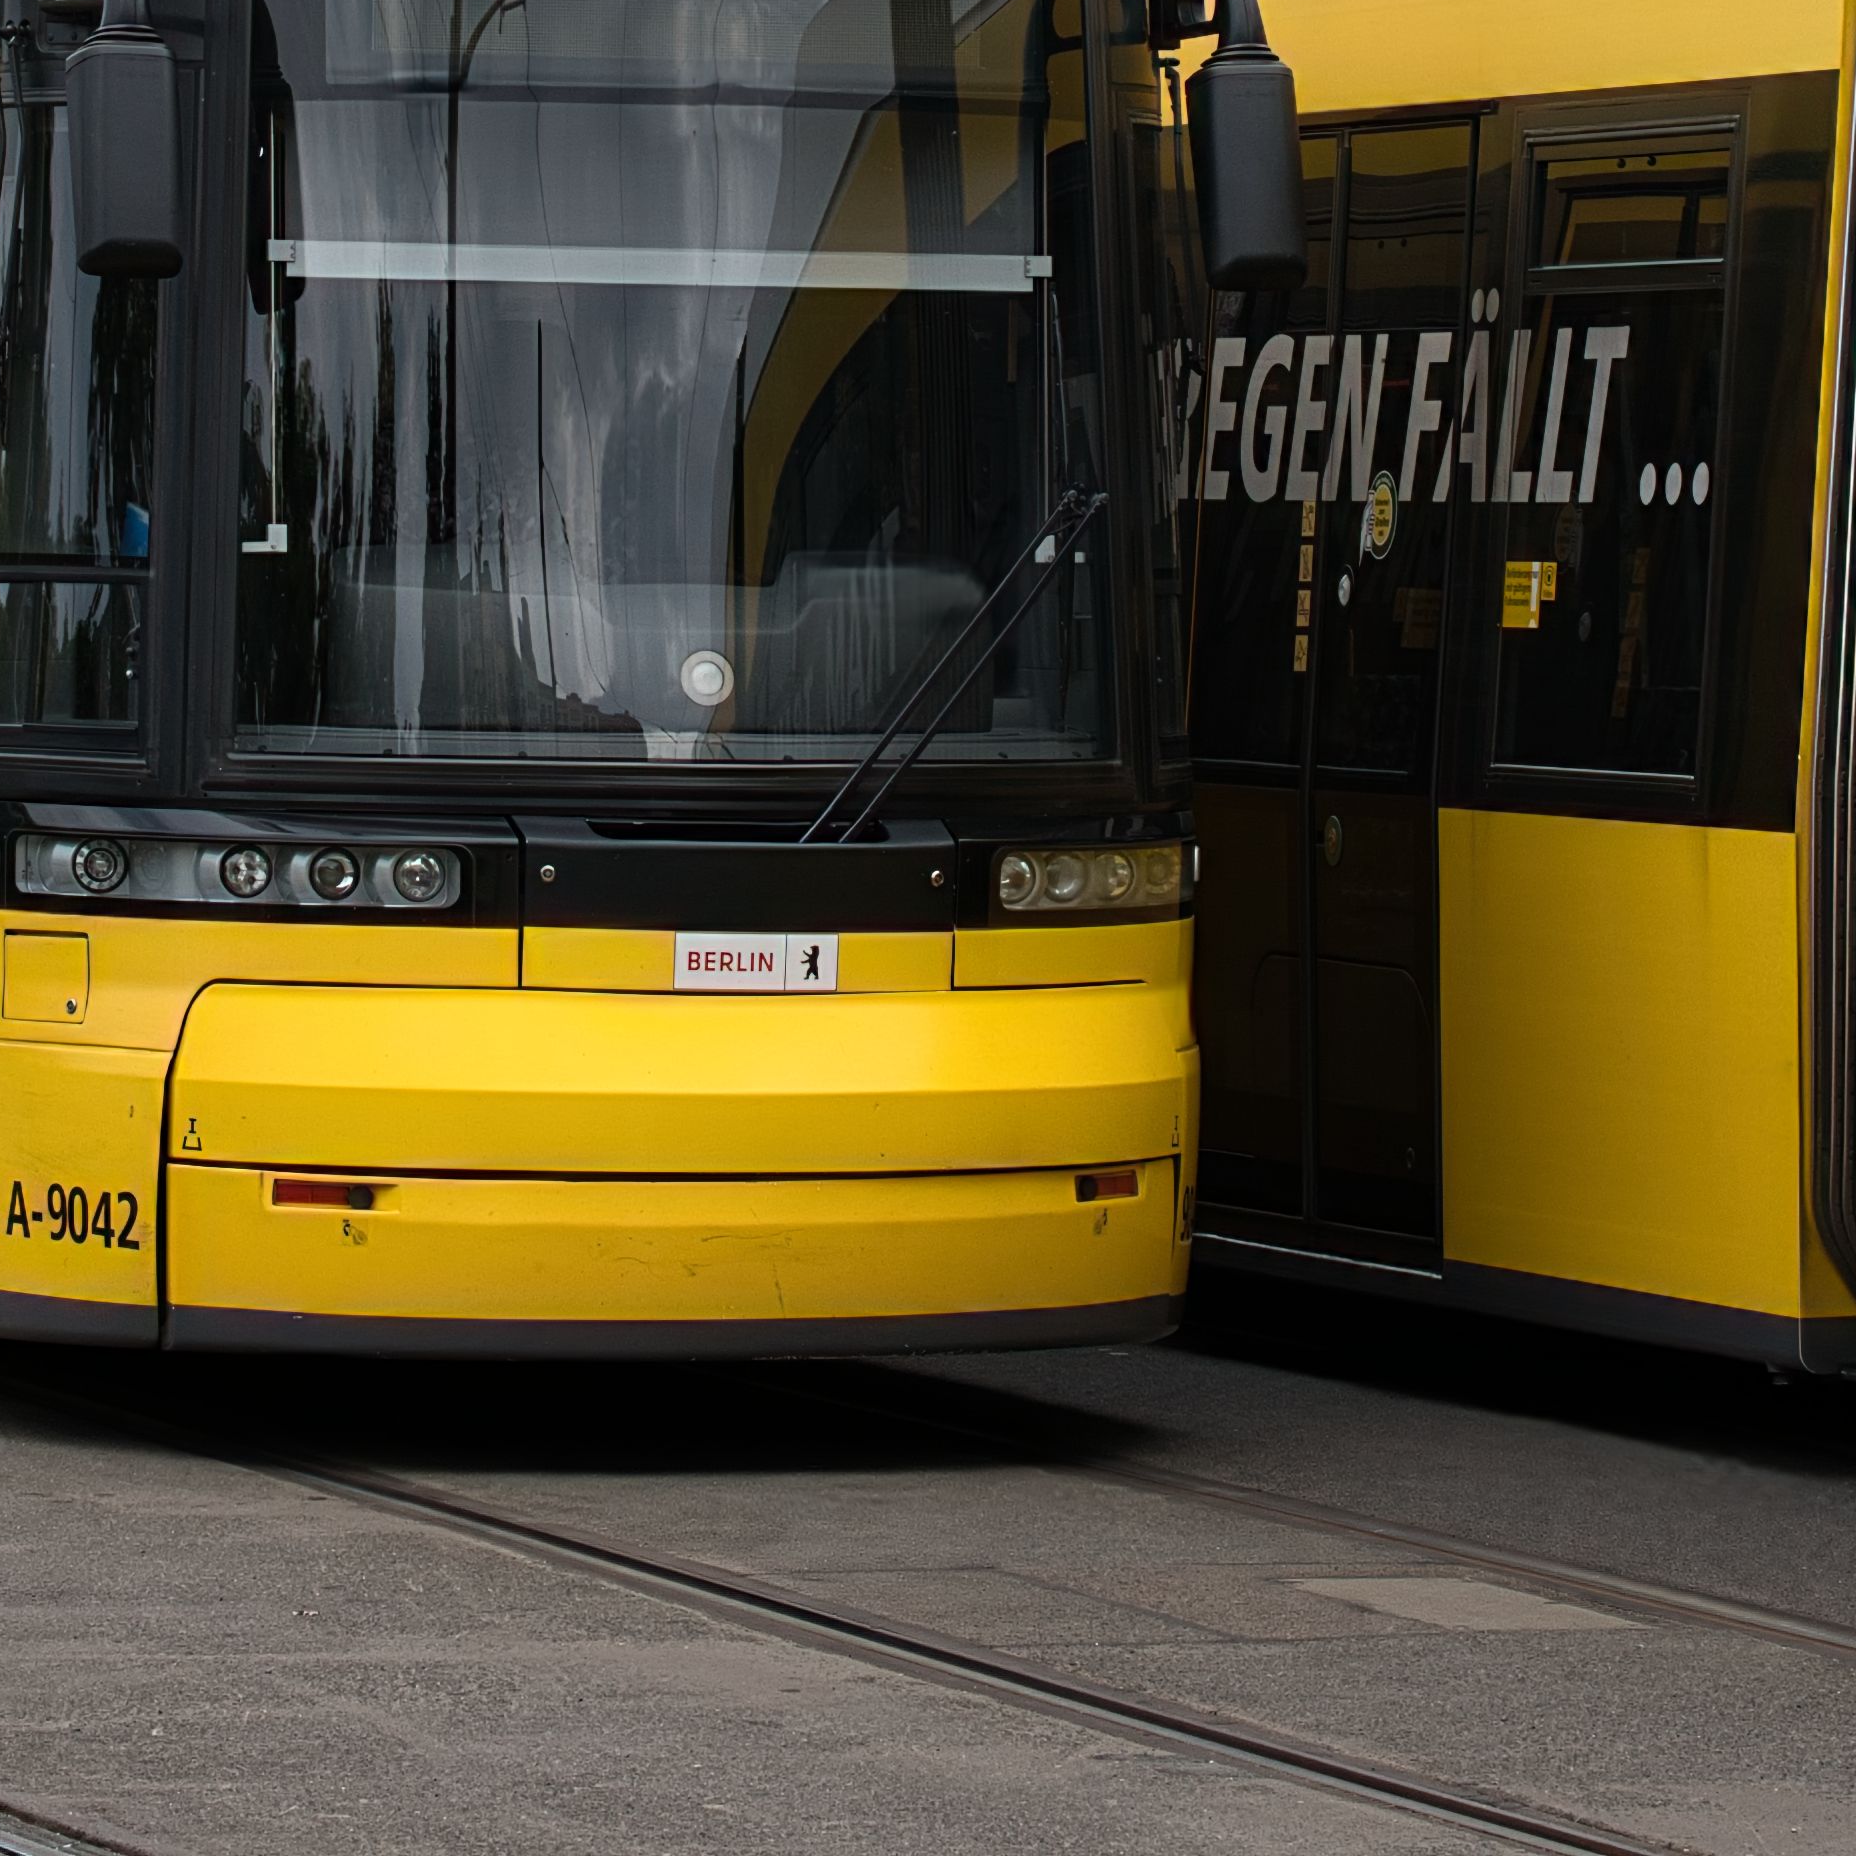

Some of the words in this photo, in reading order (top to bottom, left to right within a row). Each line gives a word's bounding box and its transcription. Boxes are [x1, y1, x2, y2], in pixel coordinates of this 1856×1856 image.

[1398, 287, 1632, 504] FÄLLT
[687, 951, 774, 972] BERLIN
[5, 1179, 141, 1251] A-9042
